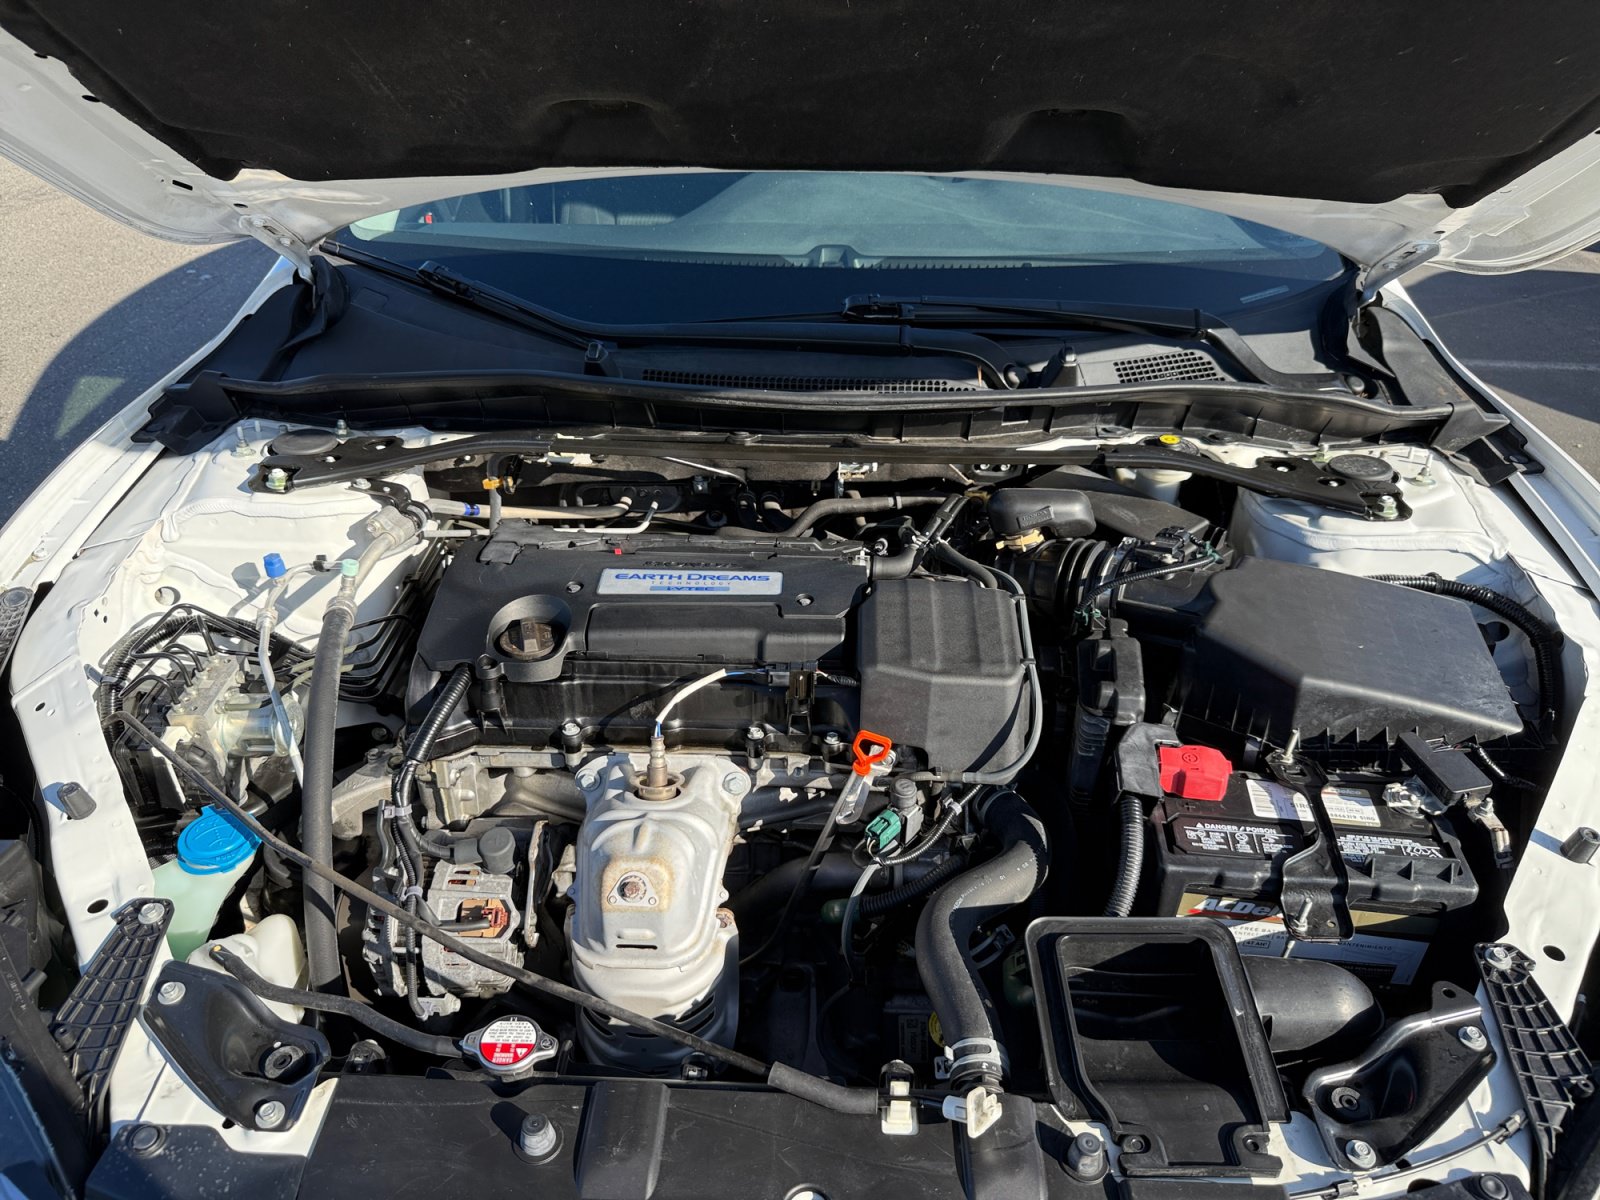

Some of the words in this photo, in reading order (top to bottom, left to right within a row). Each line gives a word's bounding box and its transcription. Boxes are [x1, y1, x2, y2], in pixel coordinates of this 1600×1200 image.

[687, 573, 770, 582] DREAMS
[1204, 823, 1238, 832] DANGER
[1246, 826, 1277, 834] POISON
[1194, 898, 1281, 916] ACDel
